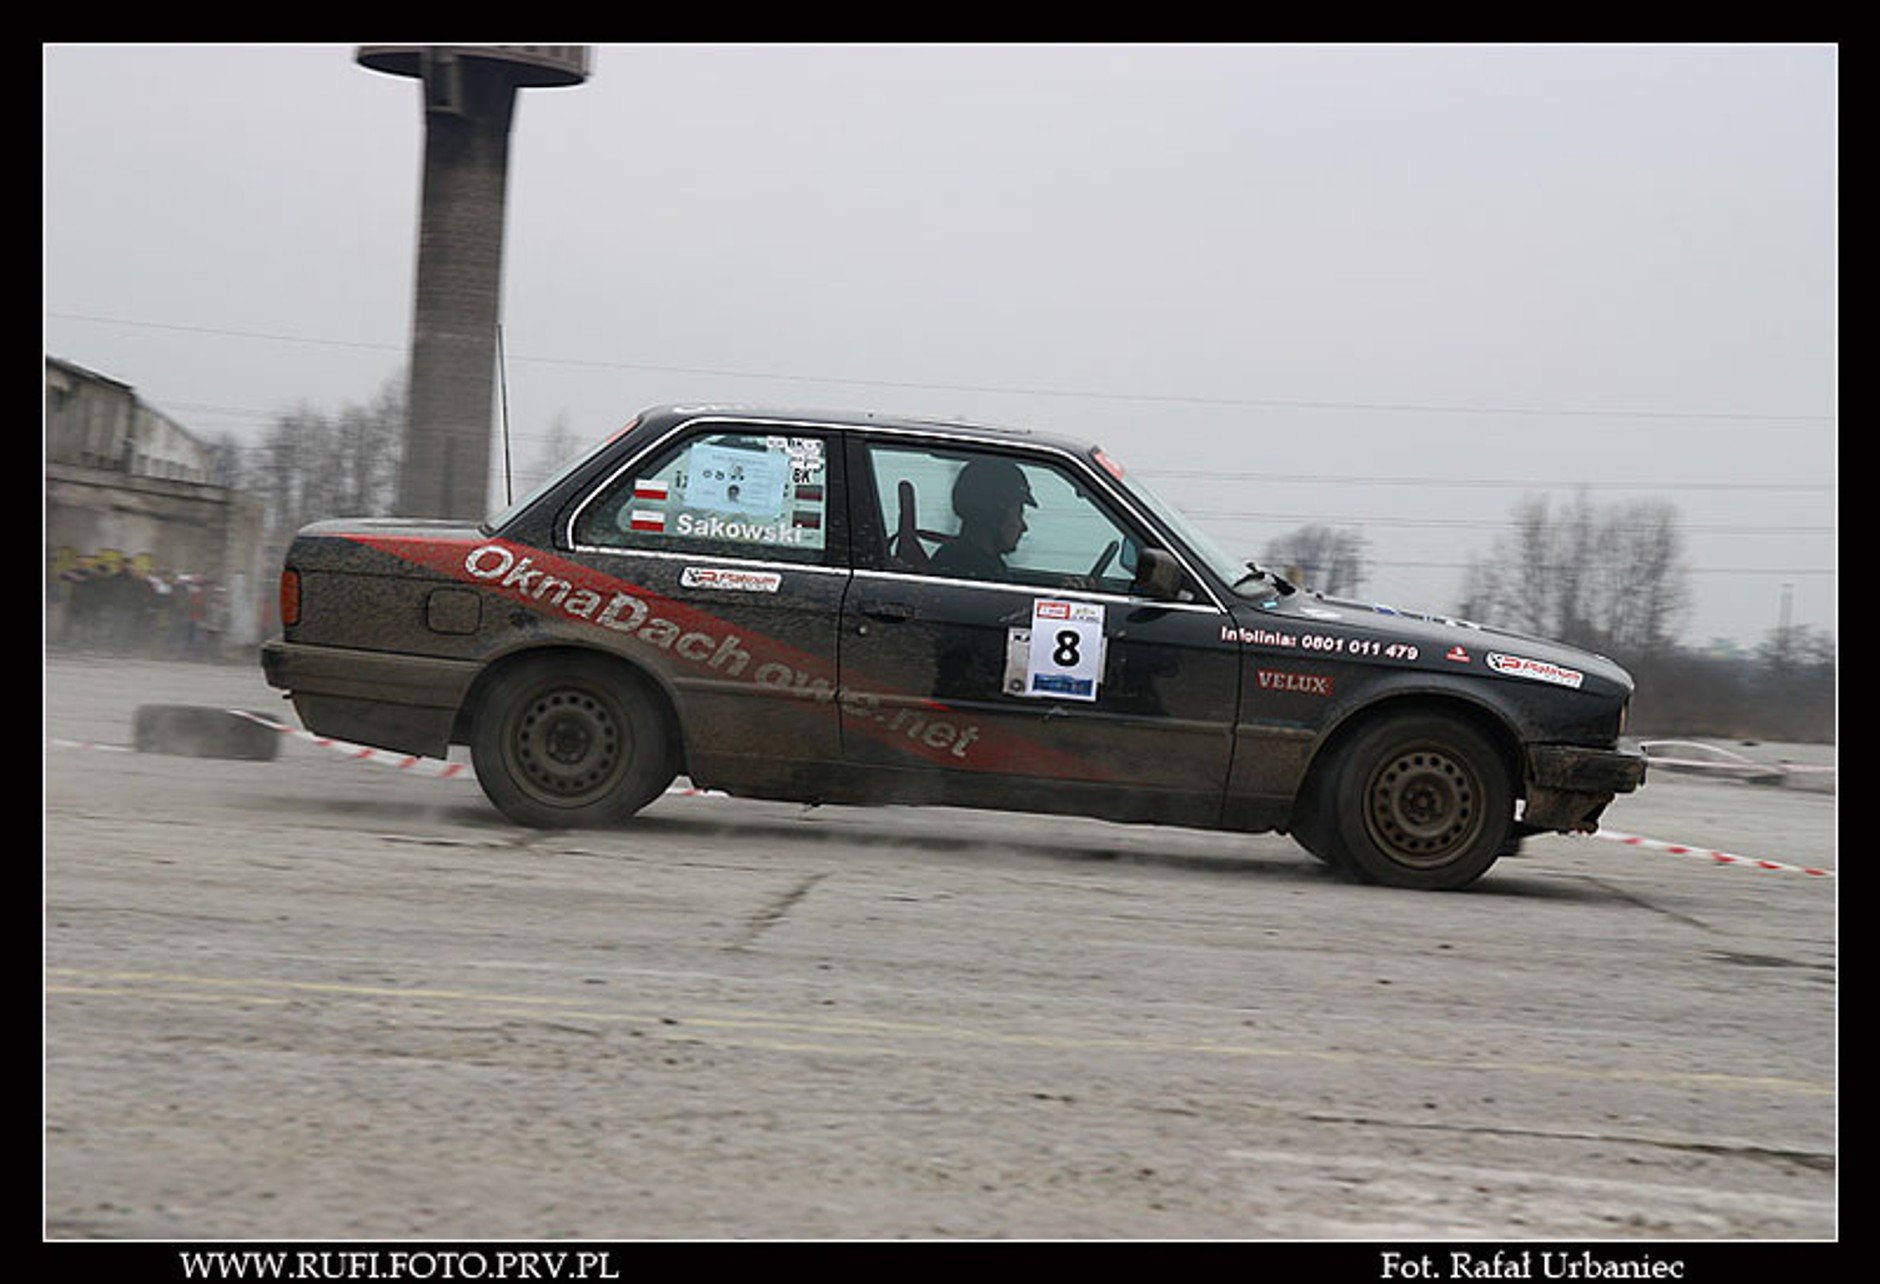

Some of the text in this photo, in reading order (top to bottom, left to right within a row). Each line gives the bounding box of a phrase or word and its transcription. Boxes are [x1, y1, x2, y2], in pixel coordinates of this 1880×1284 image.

[676, 513, 802, 544] Sakowski
[1052, 629, 1081, 667] 8
[1220, 625, 1419, 661] Infolinia: 0801 011 479
[1257, 671, 1329, 693] VELUX
